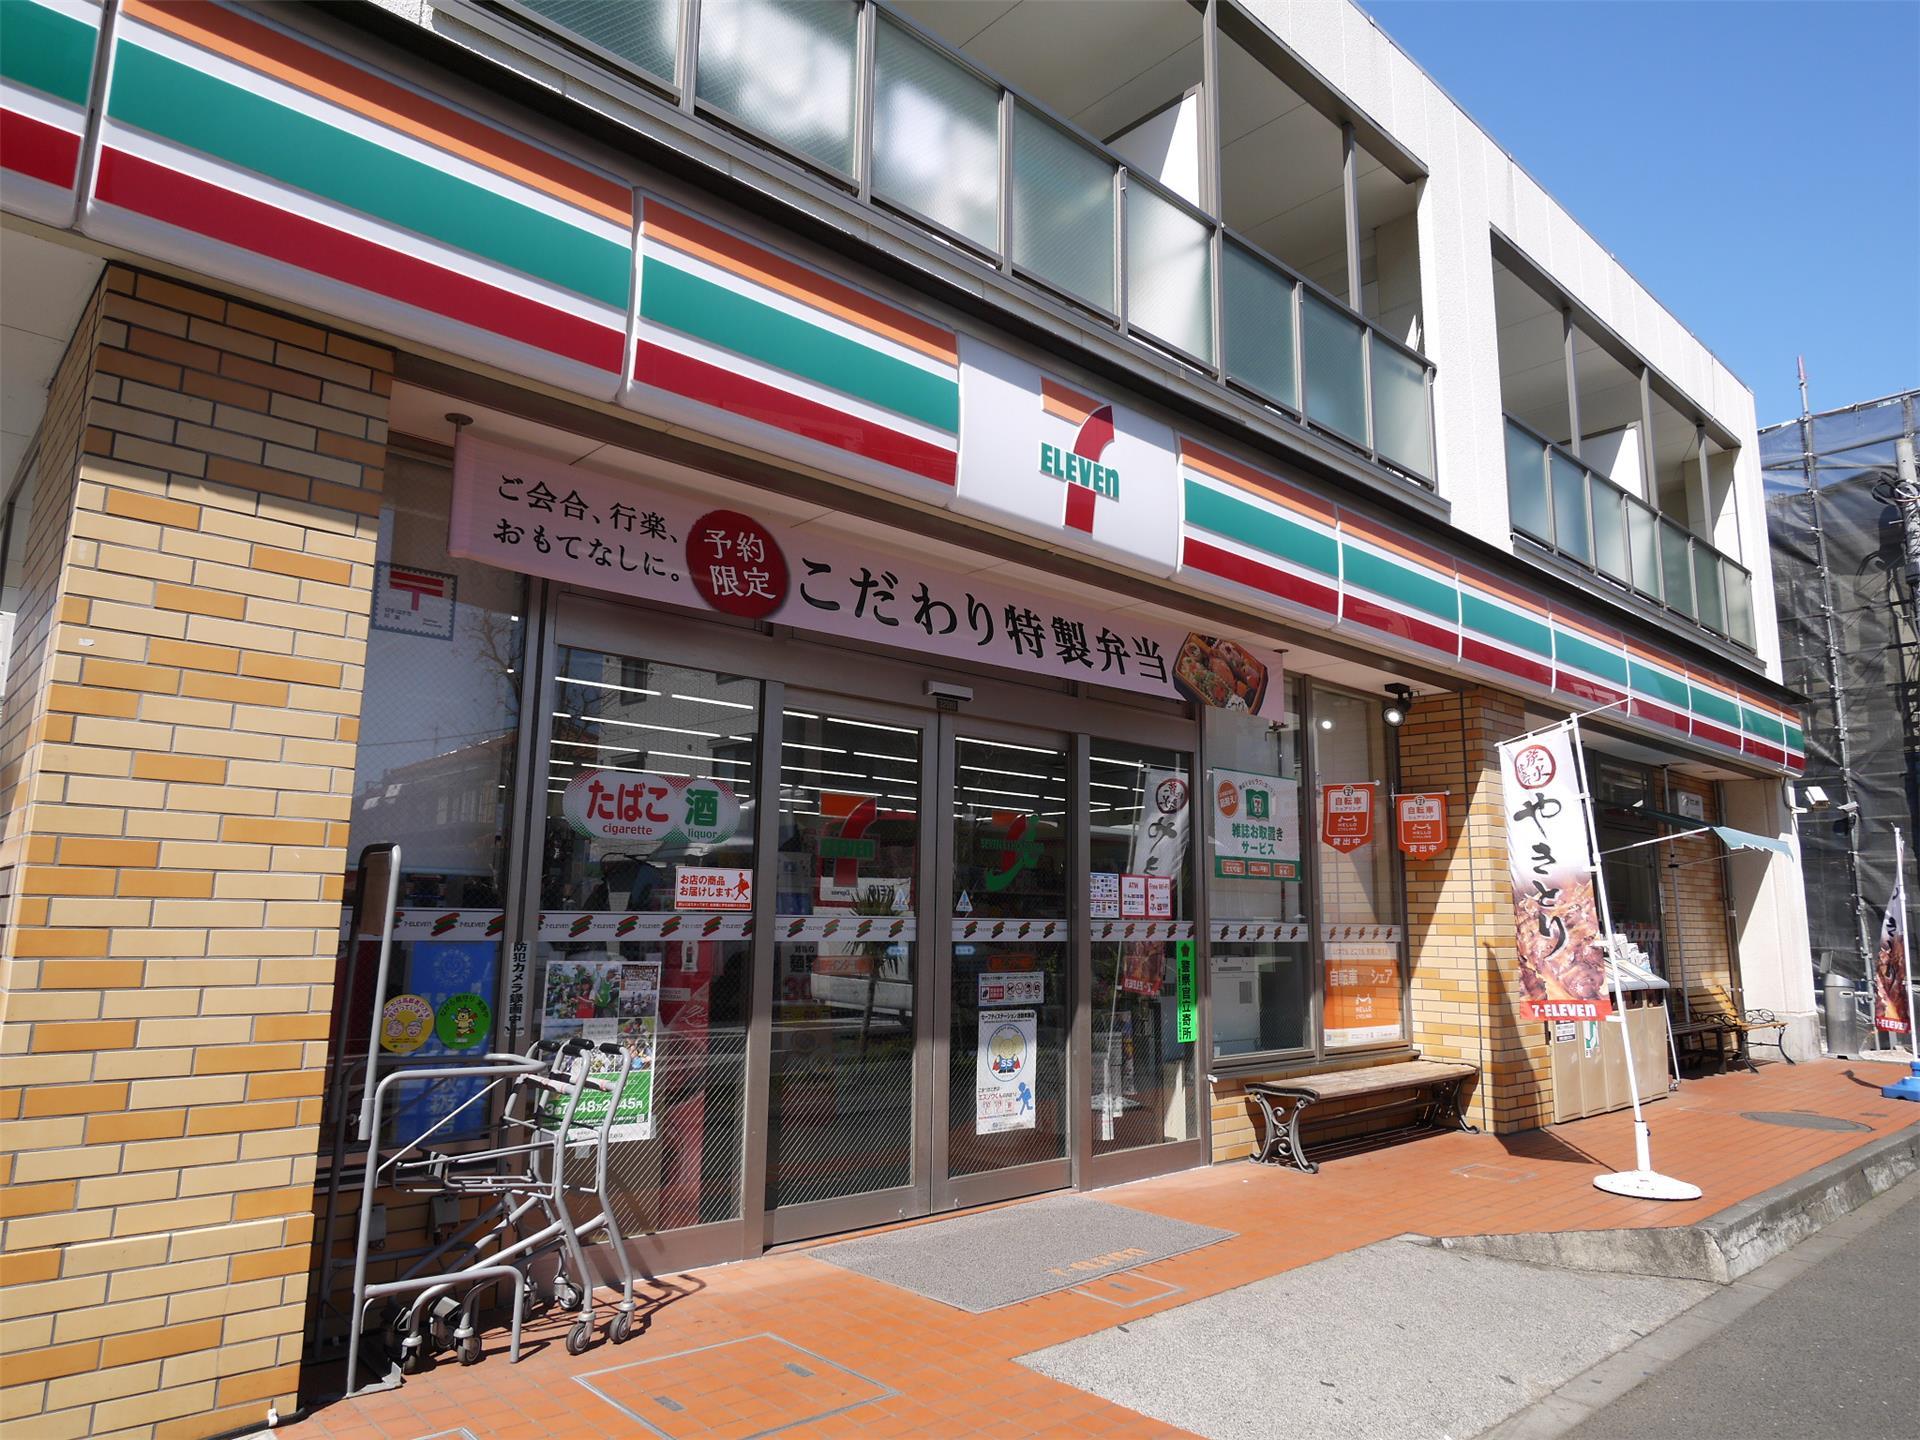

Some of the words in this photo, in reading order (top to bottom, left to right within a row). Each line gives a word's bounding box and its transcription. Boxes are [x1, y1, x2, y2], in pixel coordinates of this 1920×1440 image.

[1040, 442, 1120, 500] ELEVEN
[497, 474, 680, 545] ご会合、行楽、
[493, 518, 681, 584] おもてなしに。
[704, 528, 766, 563] 予約
[709, 564, 777, 601] 限定
[799, 556, 1168, 684] こだわり特製弁当
[586, 780, 669, 823] たばこ
[685, 787, 720, 827] 酒
[1335, 796, 1362, 806] 自転車
[1407, 805, 1434, 815] 自転車
[602, 823, 653, 836] cigarette
[688, 828, 718, 840] liquor
[1241, 841, 1275, 855] サービス
[1332, 837, 1361, 846] 貸出中
[1409, 844, 1437, 853] 貸出中
[680, 874, 726, 886] お店の商品
[1513, 792, 1570, 961] やきとり
[509, 942, 528, 1023] 防犯カメラ録画中
[1330, 969, 1358, 987] 自転車
[1370, 968, 1393, 985] シェア
[1181, 959, 1192, 1040] 警察官立寄所
[1531, 1002, 1597, 1018] 7-ELEVEN
